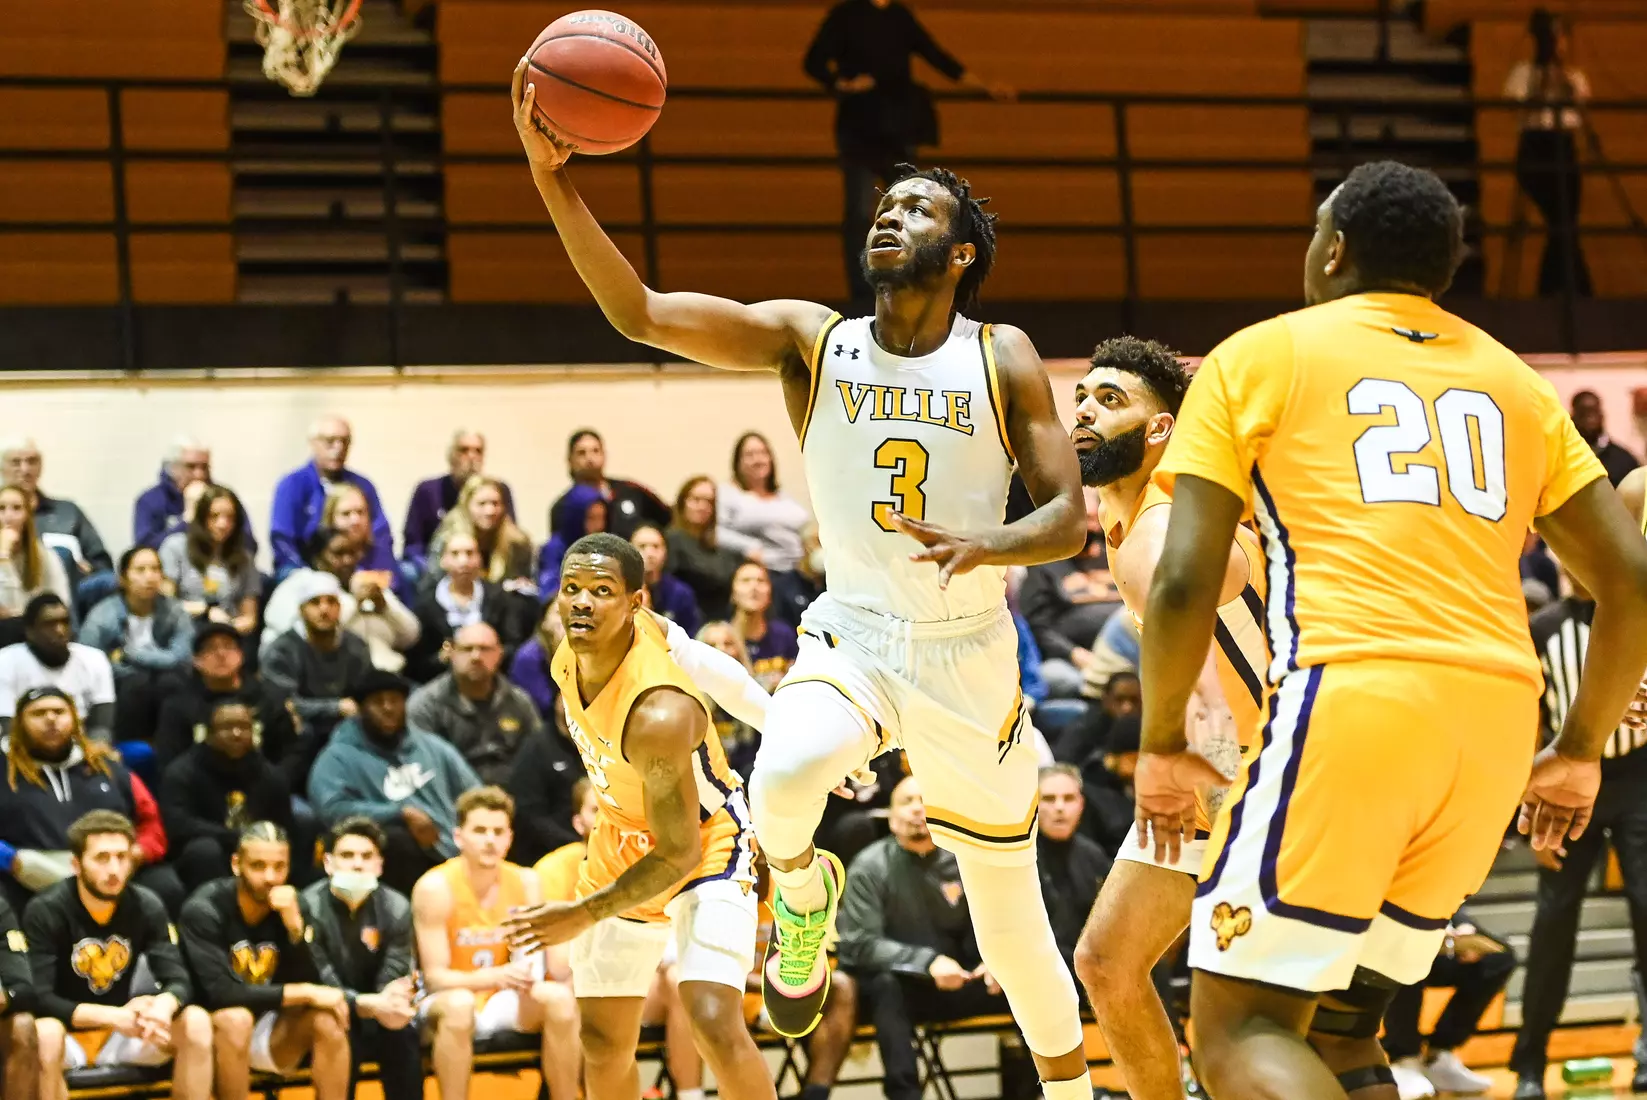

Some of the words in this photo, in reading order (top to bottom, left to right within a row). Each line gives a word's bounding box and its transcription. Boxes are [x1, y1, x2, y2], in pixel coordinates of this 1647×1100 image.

[836, 379, 974, 437] VILLE
[1346, 377, 1507, 523] 20
[871, 437, 930, 533] 3
